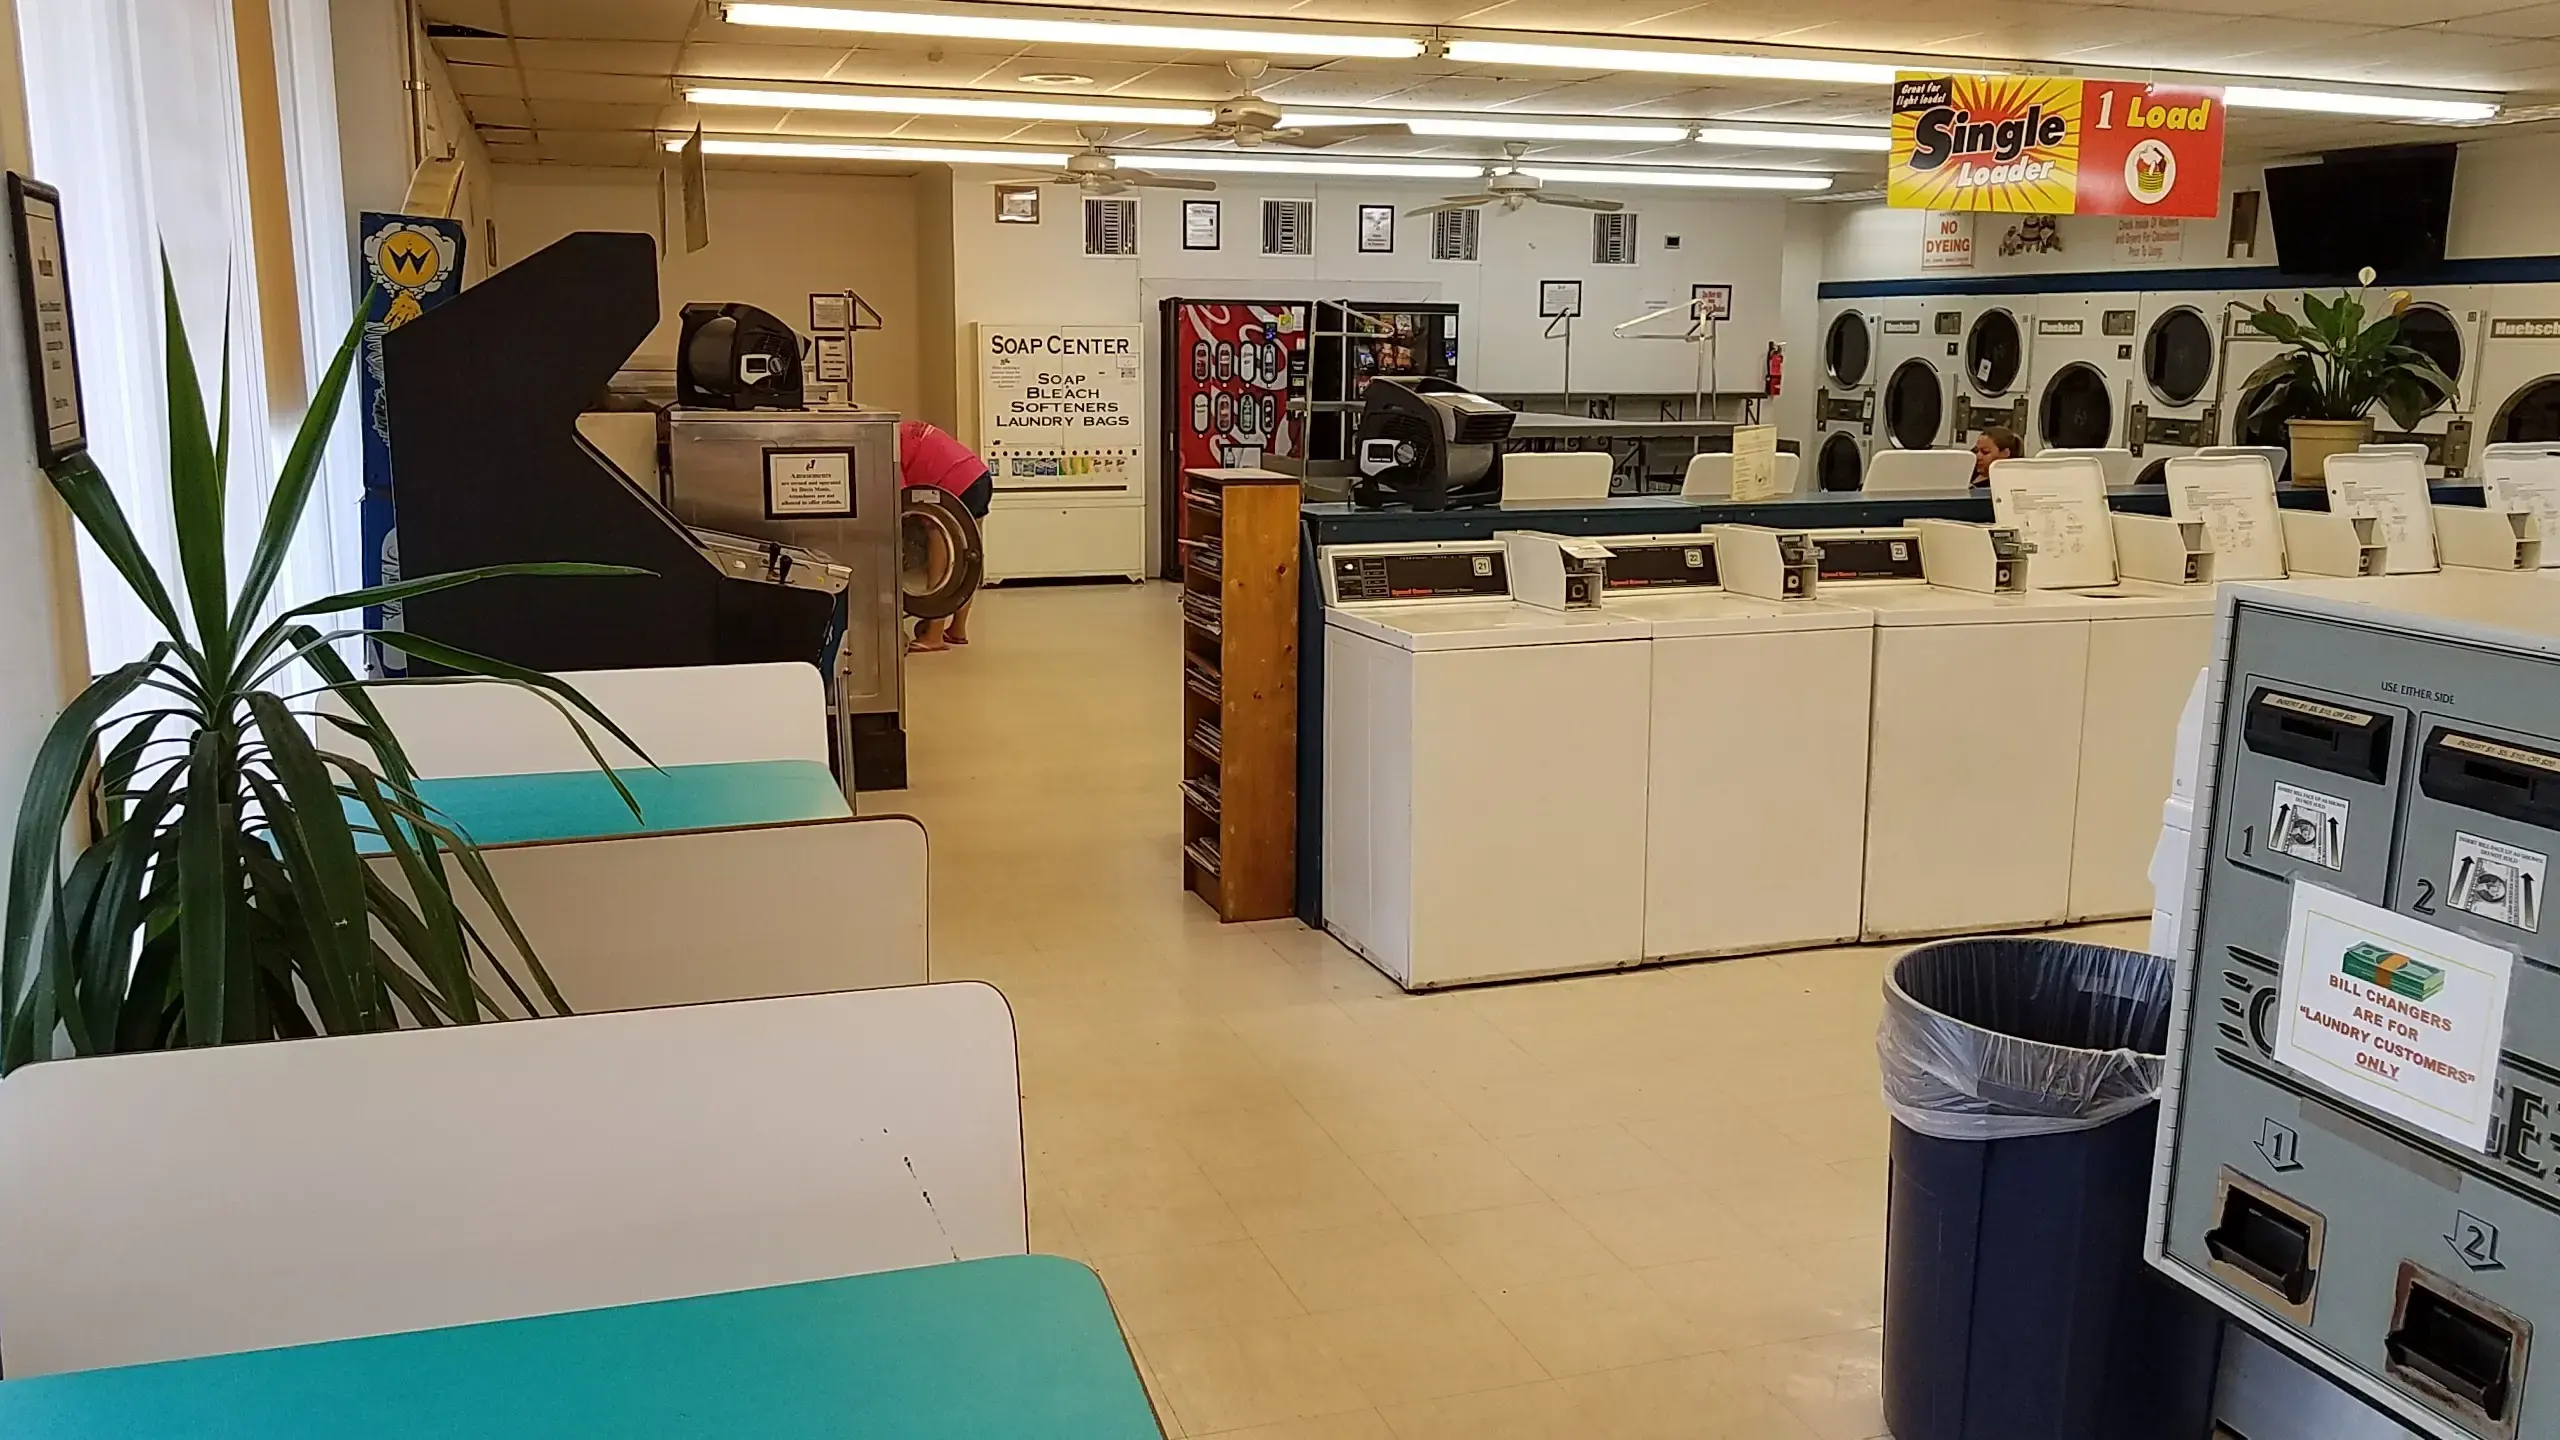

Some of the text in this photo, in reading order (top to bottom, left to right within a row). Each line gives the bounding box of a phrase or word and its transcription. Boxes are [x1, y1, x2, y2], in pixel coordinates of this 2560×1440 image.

[1896, 92, 1947, 109] light loads!
[1901, 81, 1942, 95] Great for
[2095, 90, 2212, 131] 1 Load
[1908, 103, 2067, 173] Single
[1956, 156, 2056, 189] Loader
[1941, 220, 1958, 235] NO
[1926, 238, 1970, 253] DYEING
[2041, 321, 2081, 333] Huebsch
[996, 415, 1130, 427] LAUNDRY BAGS
[2381, 681, 2455, 705] USE EITHER SIDE
[2242, 825, 2254, 858] 1
[2412, 878, 2436, 916] 2
[2329, 974, 2453, 1032] BILL CHANGERS
[2352, 1006, 2419, 1042] ARE FOR
[2355, 1052, 2400, 1082] ONLY
[2273, 1132, 2283, 1161] 1
[2464, 1225, 2485, 1261] 2
